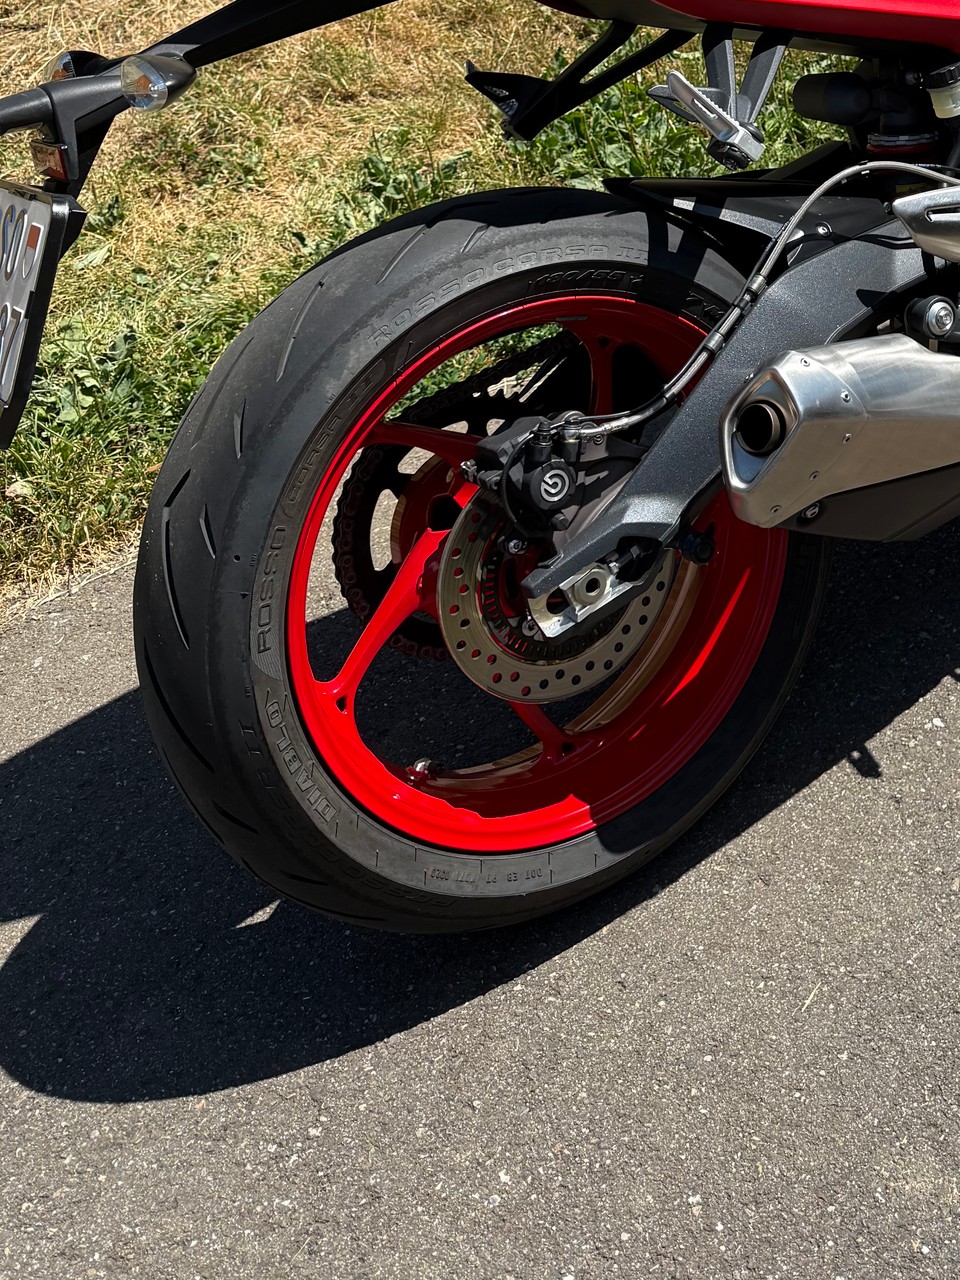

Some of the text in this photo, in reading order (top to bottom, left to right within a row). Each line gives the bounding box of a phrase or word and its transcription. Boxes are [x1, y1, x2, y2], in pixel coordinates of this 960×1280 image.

[367, 267, 485, 346] ROSSO
[492, 244, 610, 272] CORSA
[257, 525, 288, 655] ROSSO
[287, 415, 342, 504] CORSA
[264, 699, 338, 825] DIABLO
